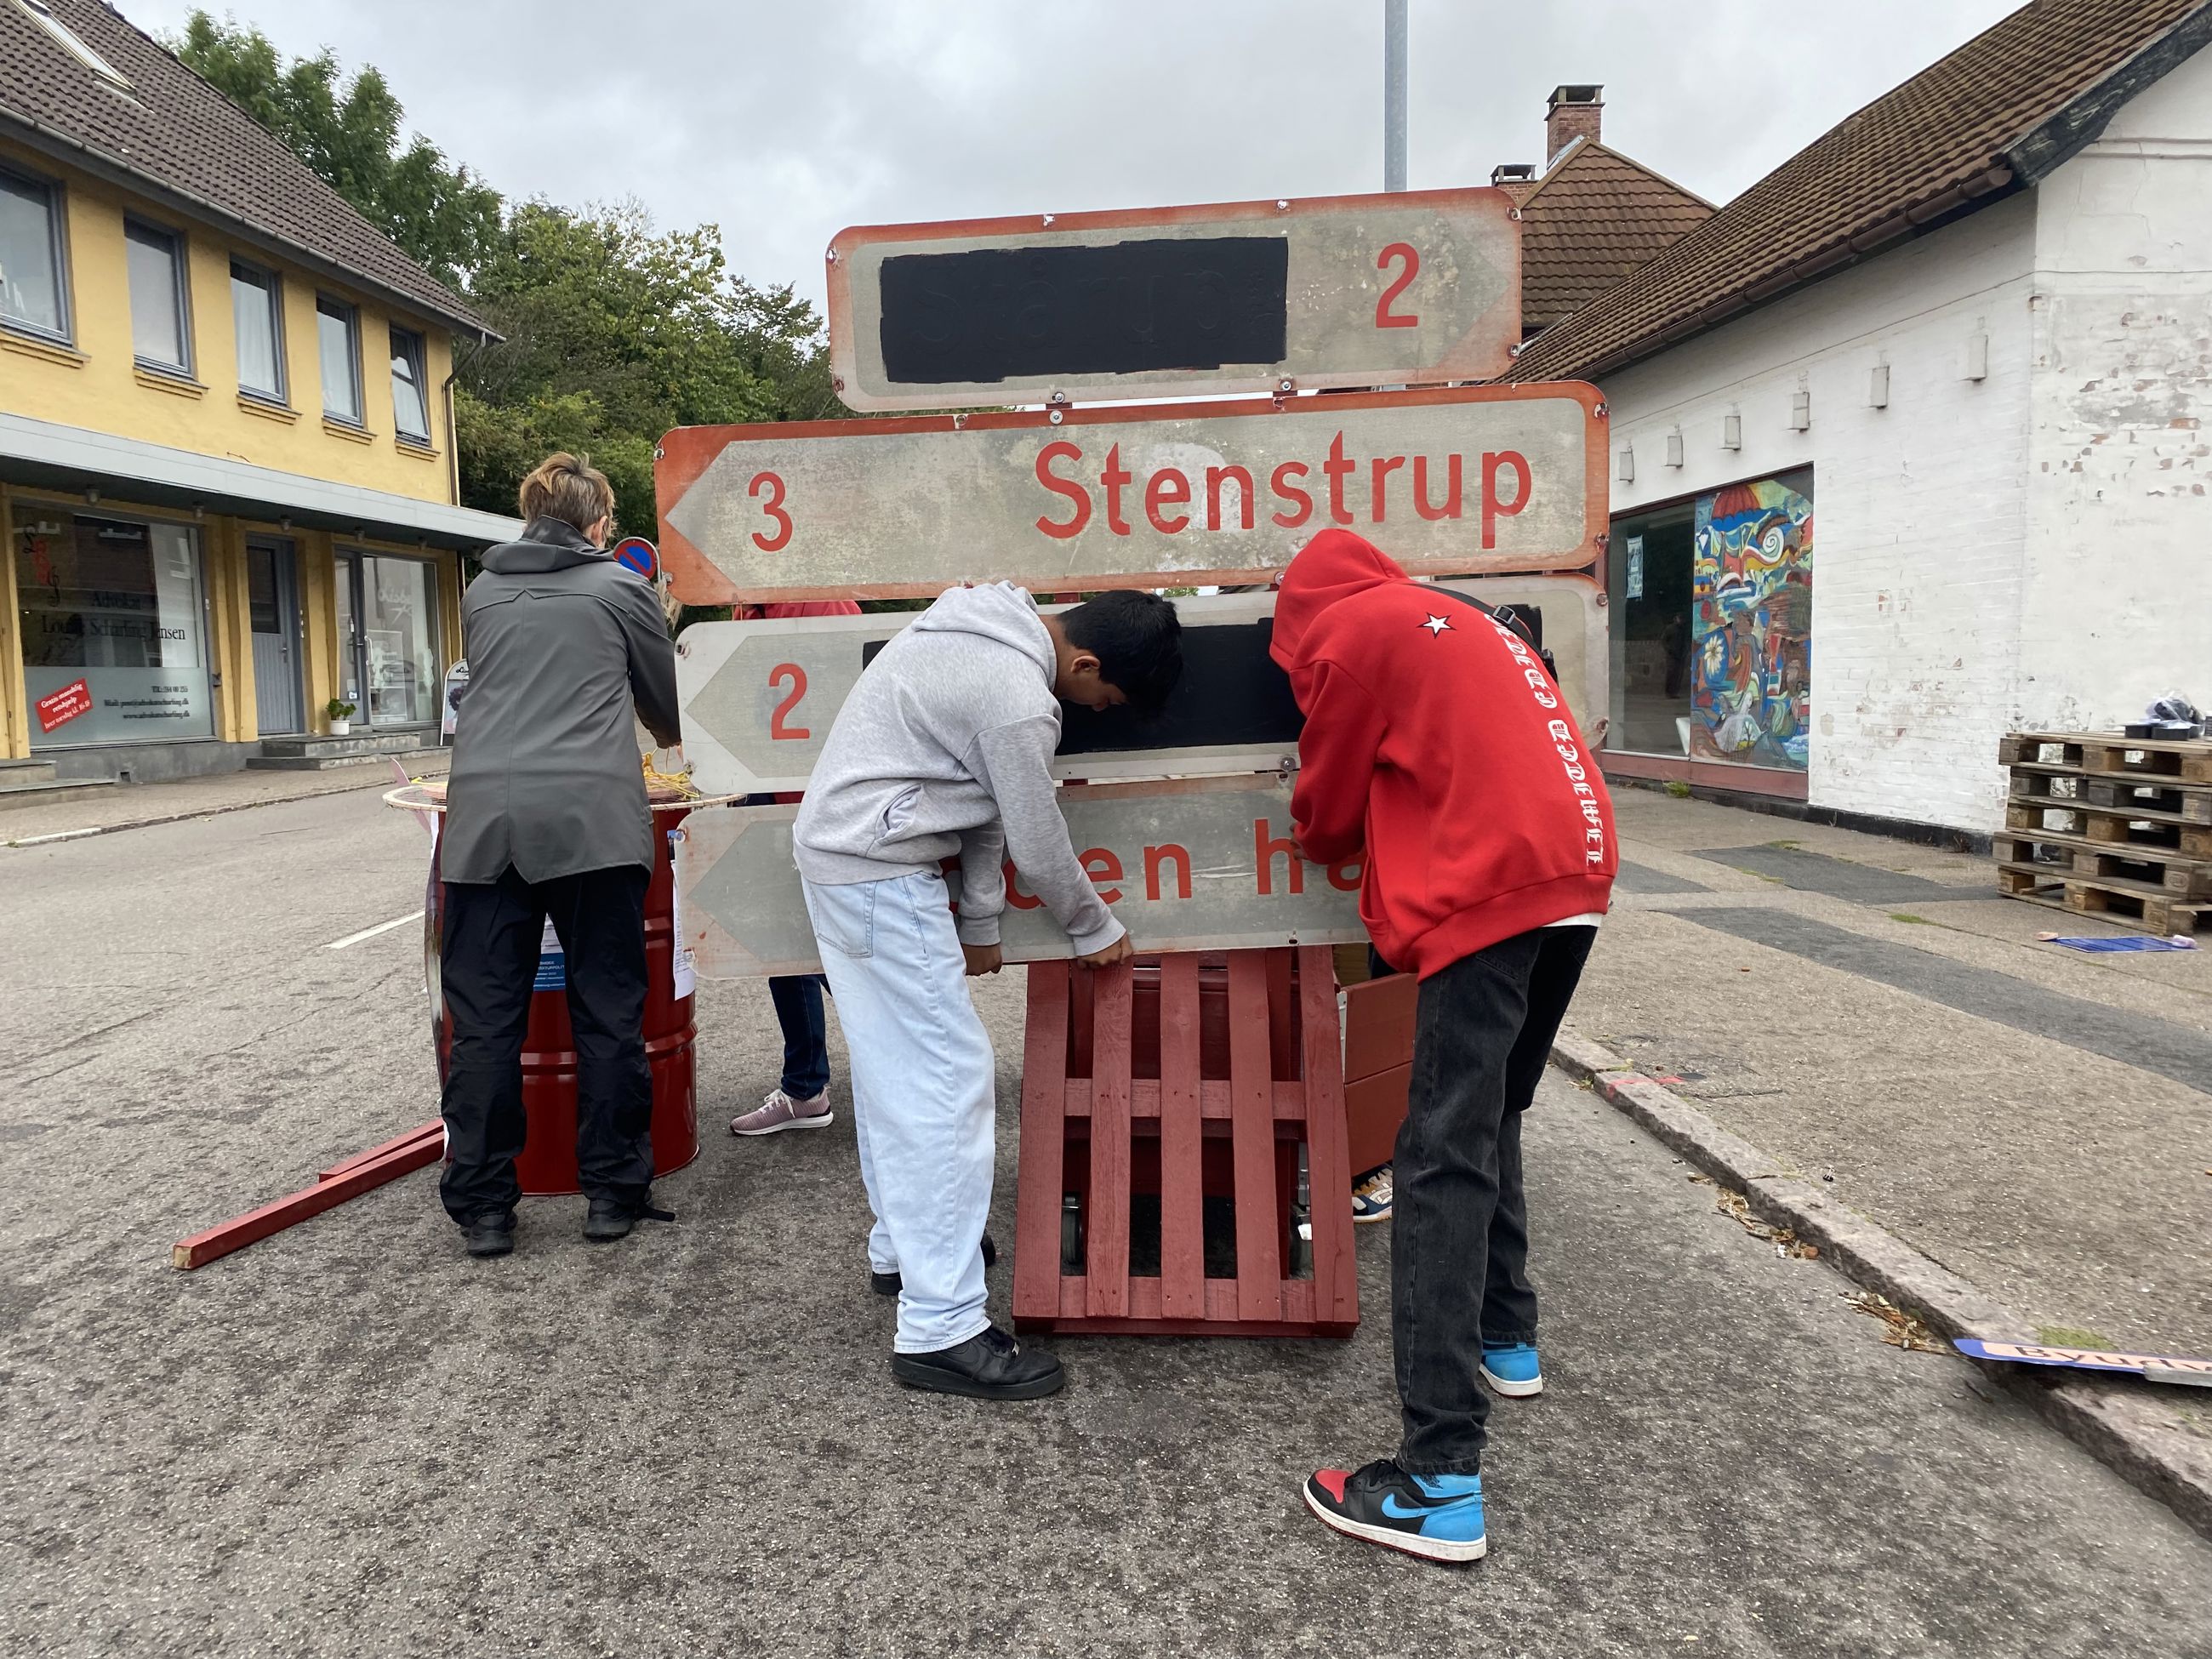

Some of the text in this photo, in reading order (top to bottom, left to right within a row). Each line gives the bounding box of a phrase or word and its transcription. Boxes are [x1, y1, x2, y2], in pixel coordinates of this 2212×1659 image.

[1376, 242, 1420, 328] 2
[748, 471, 793, 552] 3
[1035, 430, 1532, 550] Stenstrup
[768, 663, 810, 740] 2
[1548, 719, 1604, 867] LIMITED
